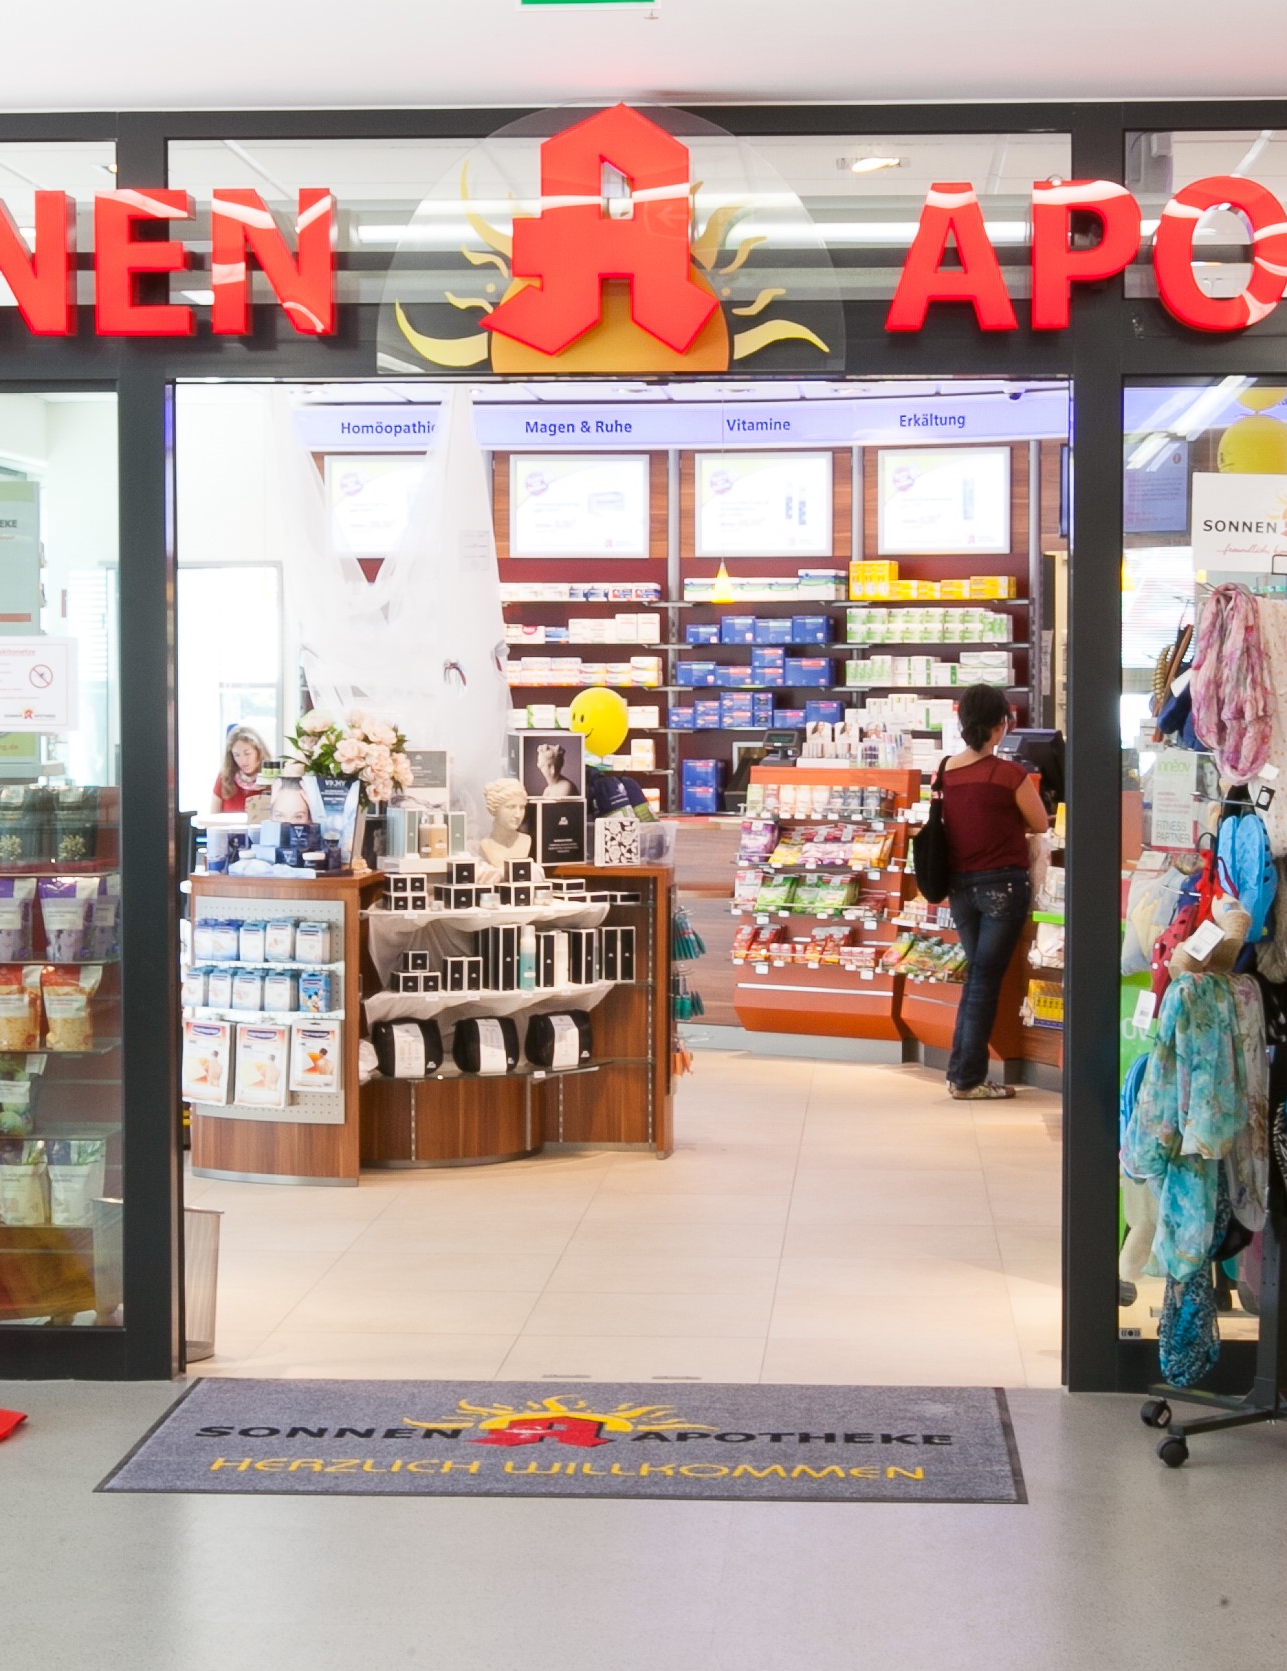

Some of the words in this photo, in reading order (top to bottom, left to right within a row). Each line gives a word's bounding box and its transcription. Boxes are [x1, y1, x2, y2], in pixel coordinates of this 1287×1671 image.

[525, 420, 575, 437] Magen
[580, 420, 591, 434] &
[595, 420, 633, 434] Ruhe
[726, 418, 791, 432] Vitamine
[899, 414, 966, 429] Erkältung
[1203, 519, 1277, 534] SONNEN
[1156, 820, 1187, 832] FITNESS
[1156, 832, 1191, 844] PARTNER
[193, 1424, 465, 1443] SONNEN
[629, 1428, 955, 1447] APOTHEKE
[208, 1456, 481, 1476] HERZLICH
[503, 1459, 926, 1481] WILLKOMMEN
